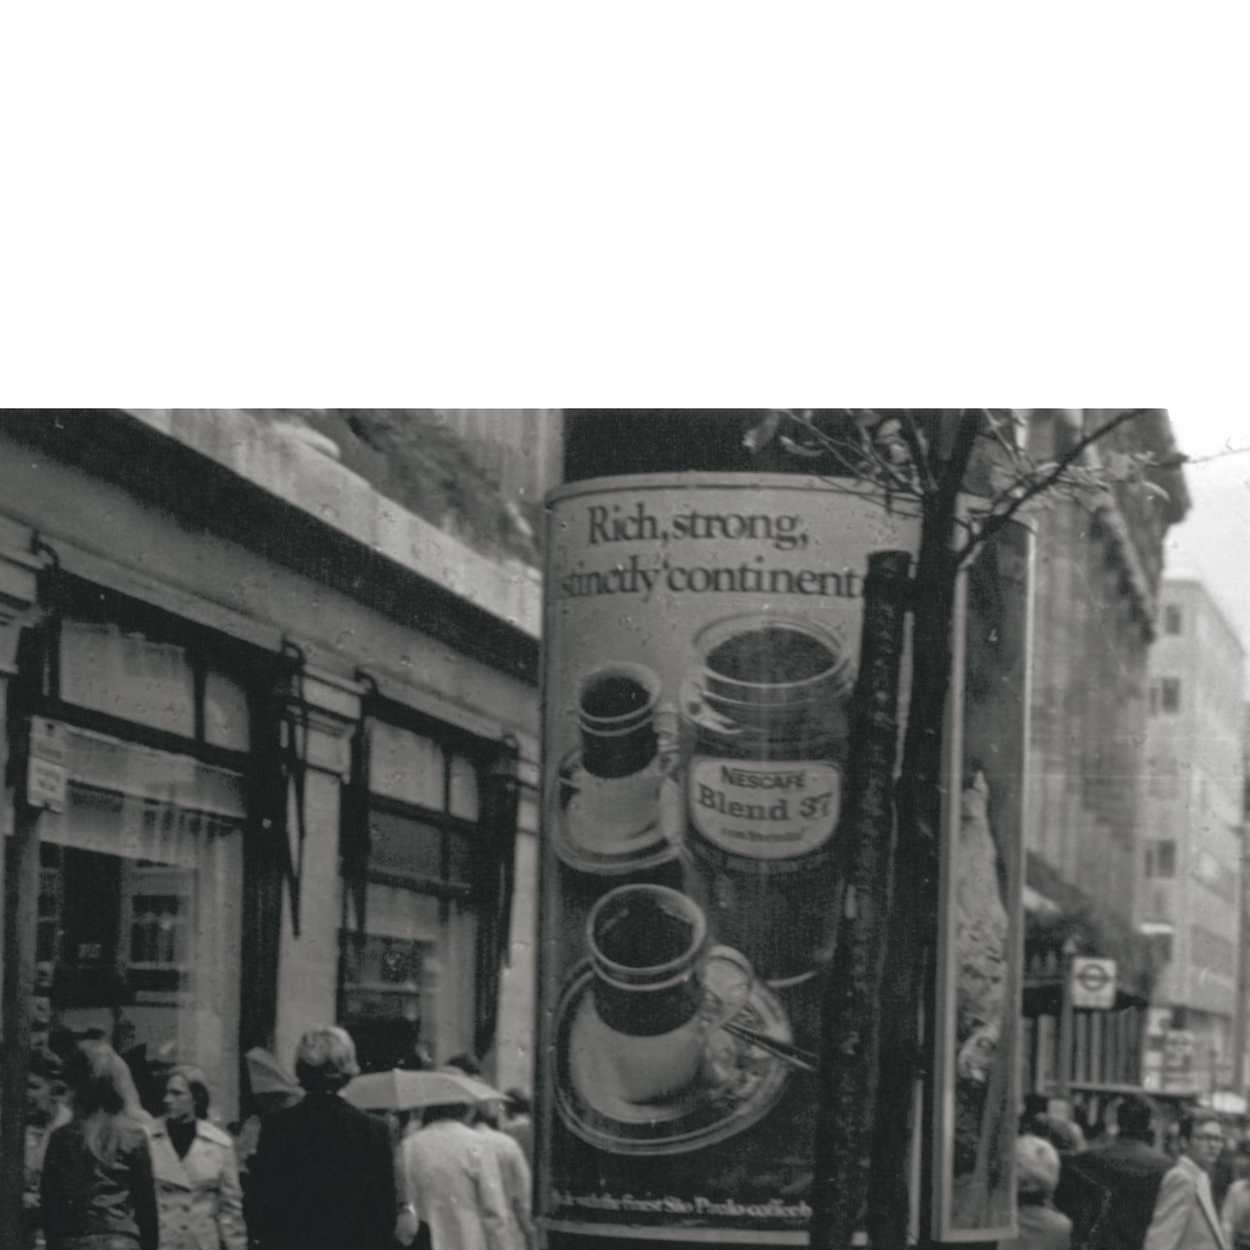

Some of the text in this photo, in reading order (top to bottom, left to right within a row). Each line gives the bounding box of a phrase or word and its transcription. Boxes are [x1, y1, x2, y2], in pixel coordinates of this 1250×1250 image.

[588, 503, 809, 551] Rich, strong,
[698, 782, 790, 821] Blend
